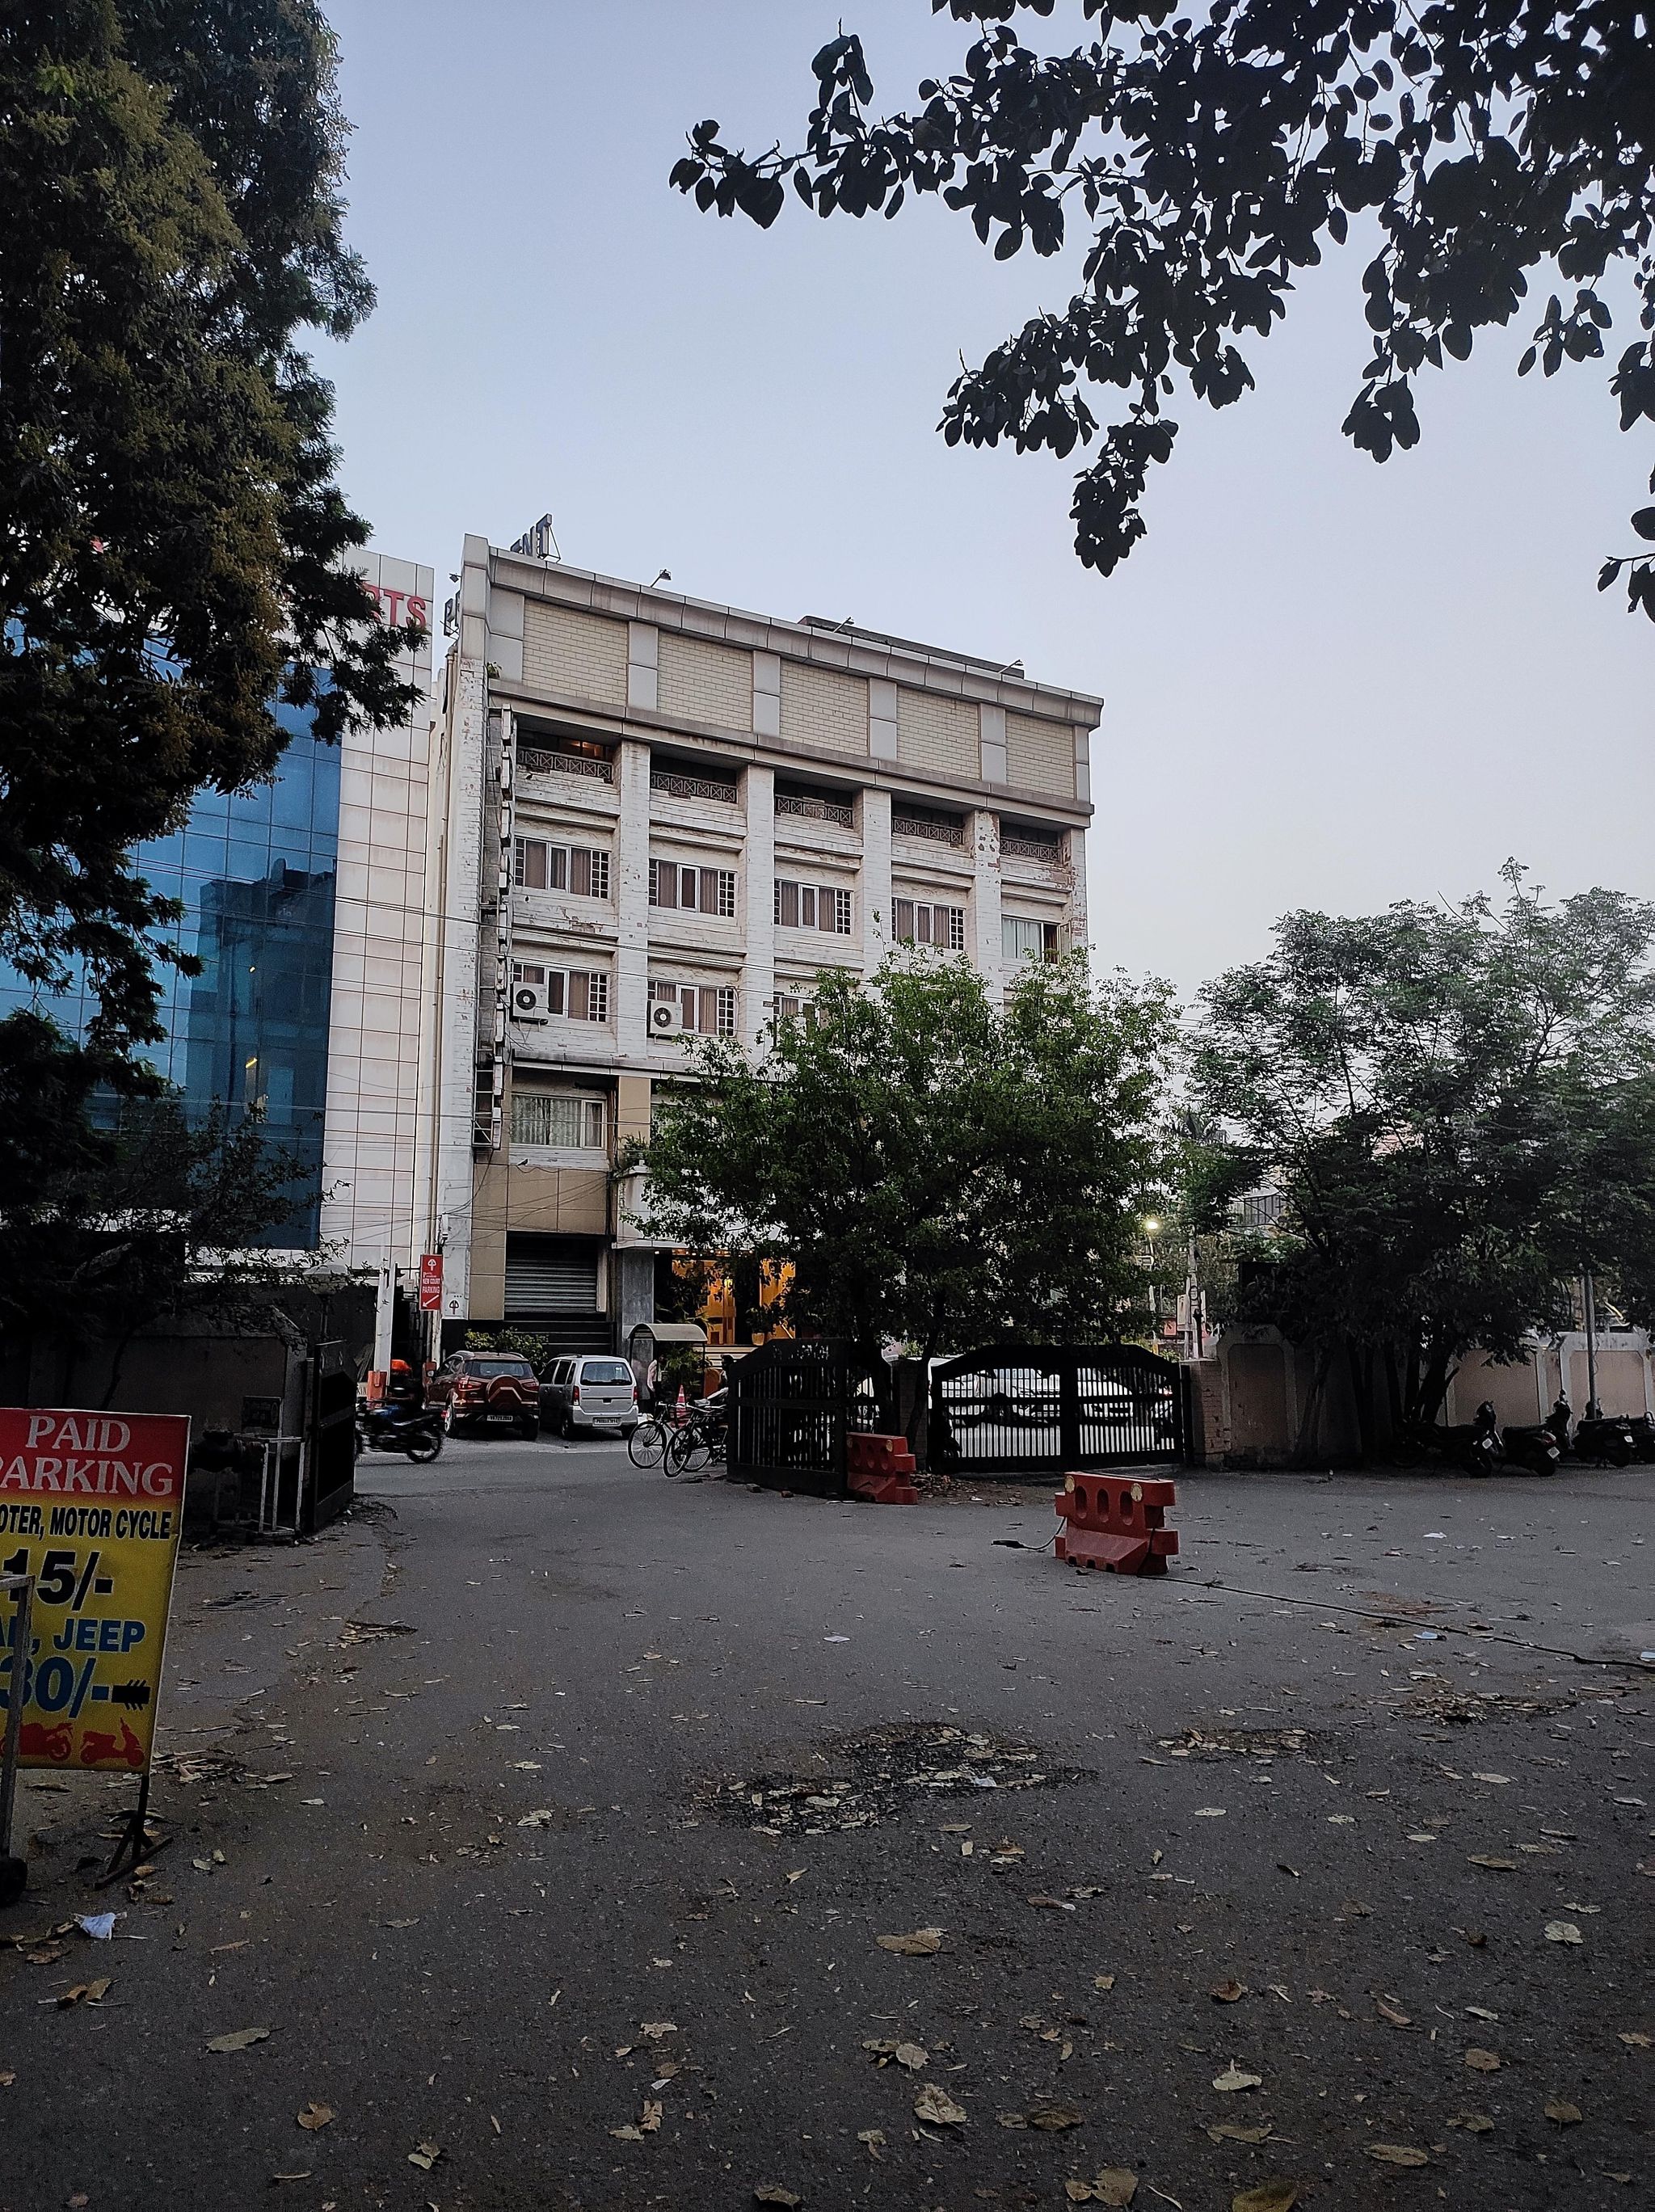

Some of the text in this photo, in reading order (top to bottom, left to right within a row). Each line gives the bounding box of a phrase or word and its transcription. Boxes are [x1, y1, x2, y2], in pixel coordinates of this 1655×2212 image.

[25, 1415, 131, 1452] PAID
[0, 1456, 173, 1495] ARKING
[49, 1506, 112, 1538] MOTOR
[116, 1510, 172, 1540] CYCLE
[53, 1618, 146, 1653] JEEP
